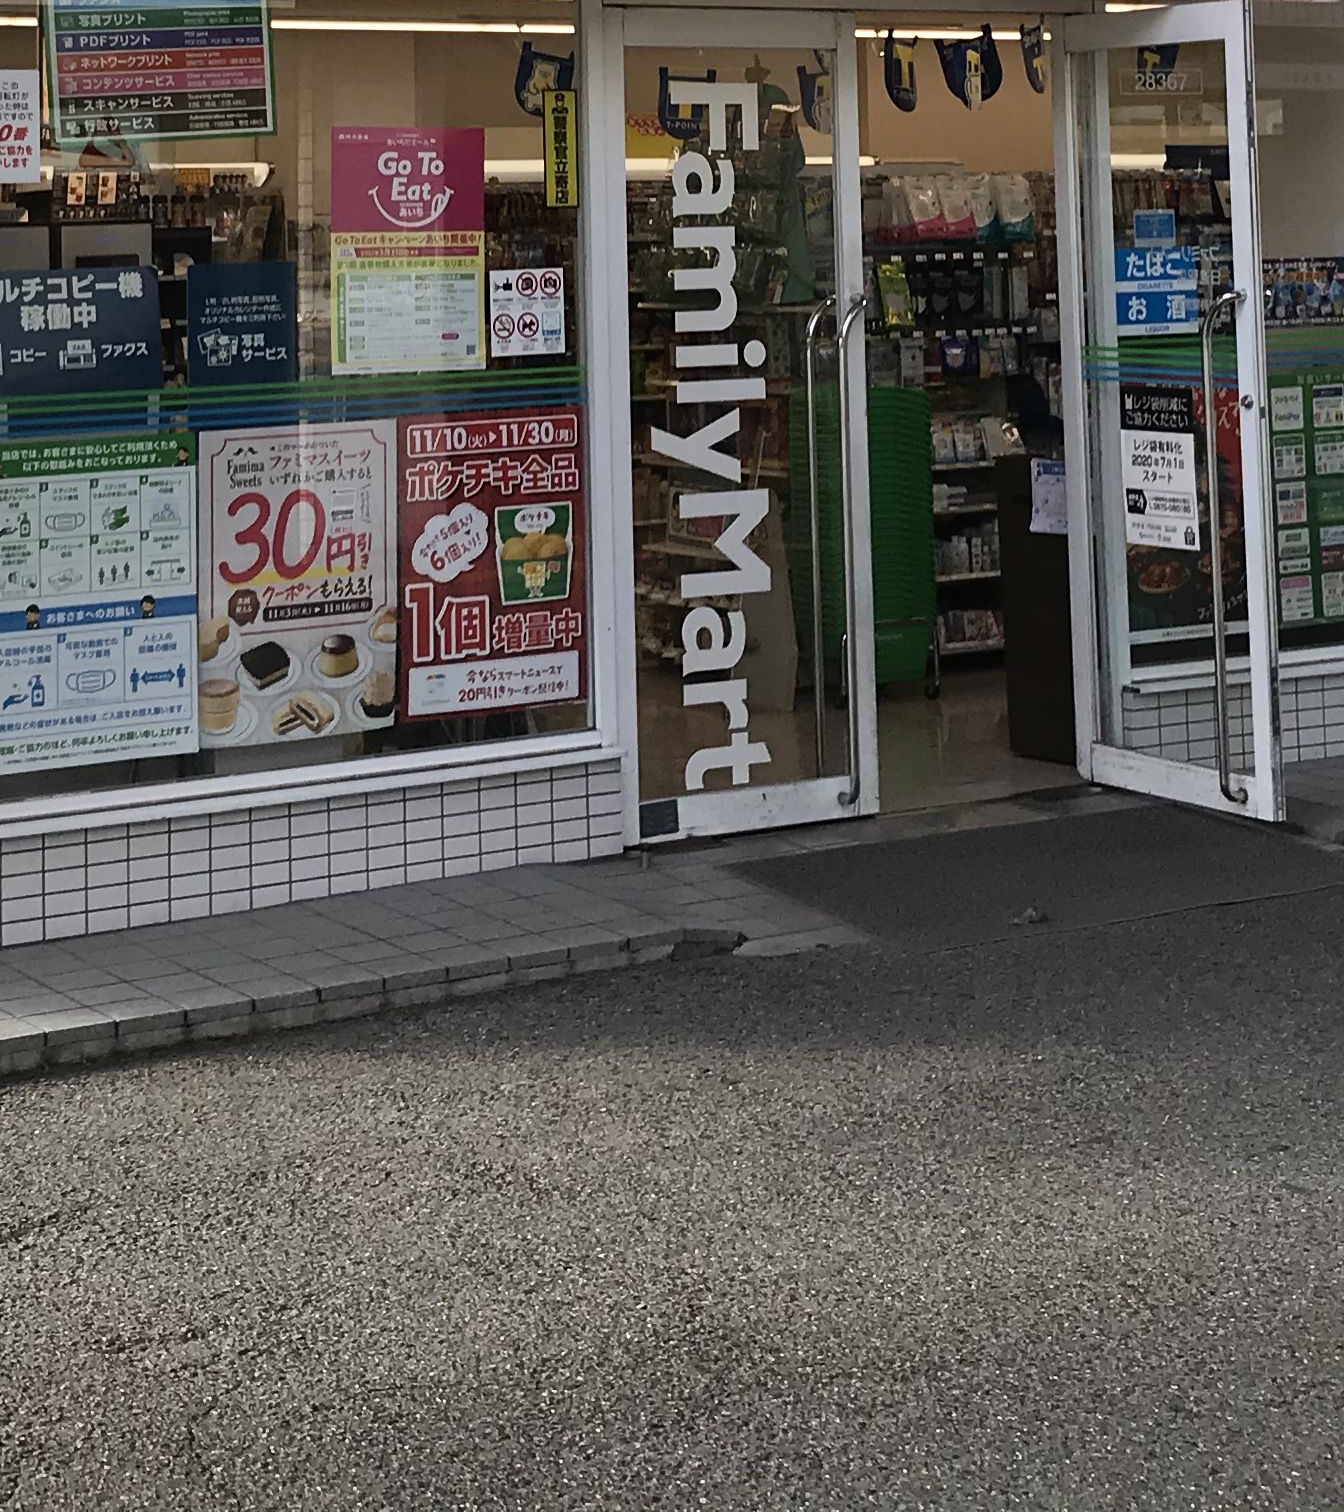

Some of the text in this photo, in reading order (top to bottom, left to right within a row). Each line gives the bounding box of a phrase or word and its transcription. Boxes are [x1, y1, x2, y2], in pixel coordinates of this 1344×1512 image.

[79, 13, 146, 27] 写真プリント
[80, 33, 151, 47] PDFプリント
[81, 55, 172, 69] ネットワークプリント
[82, 75, 175, 90] コンテンツサービス
[1135, 73, 1188, 91] 28367
[84, 96, 174, 111] スキャンサービス
[377, 151, 445, 176] Go To
[391, 177, 432, 201] Eat
[1126, 252, 1183, 278] たばこ
[20, 302, 97, 331] 稼働中
[10, 348, 47, 363] コピー
[101, 341, 149, 359] ファクス
[242, 347, 288, 362] サービス
[650, 81, 773, 791] FamilyMart
[227, 459, 264, 474] Famima
[270, 449, 371, 470] ファミマスイーツ
[229, 475, 262, 489] Sweets
[406, 453, 579, 503] ポケチキ全品
[1143, 470, 1173, 484] スタート
[263, 574, 373, 606] クーポンもらえる!
[46, 606, 135, 624] お客さまへのお願い
[405, 582, 582, 663] 1個増量中
